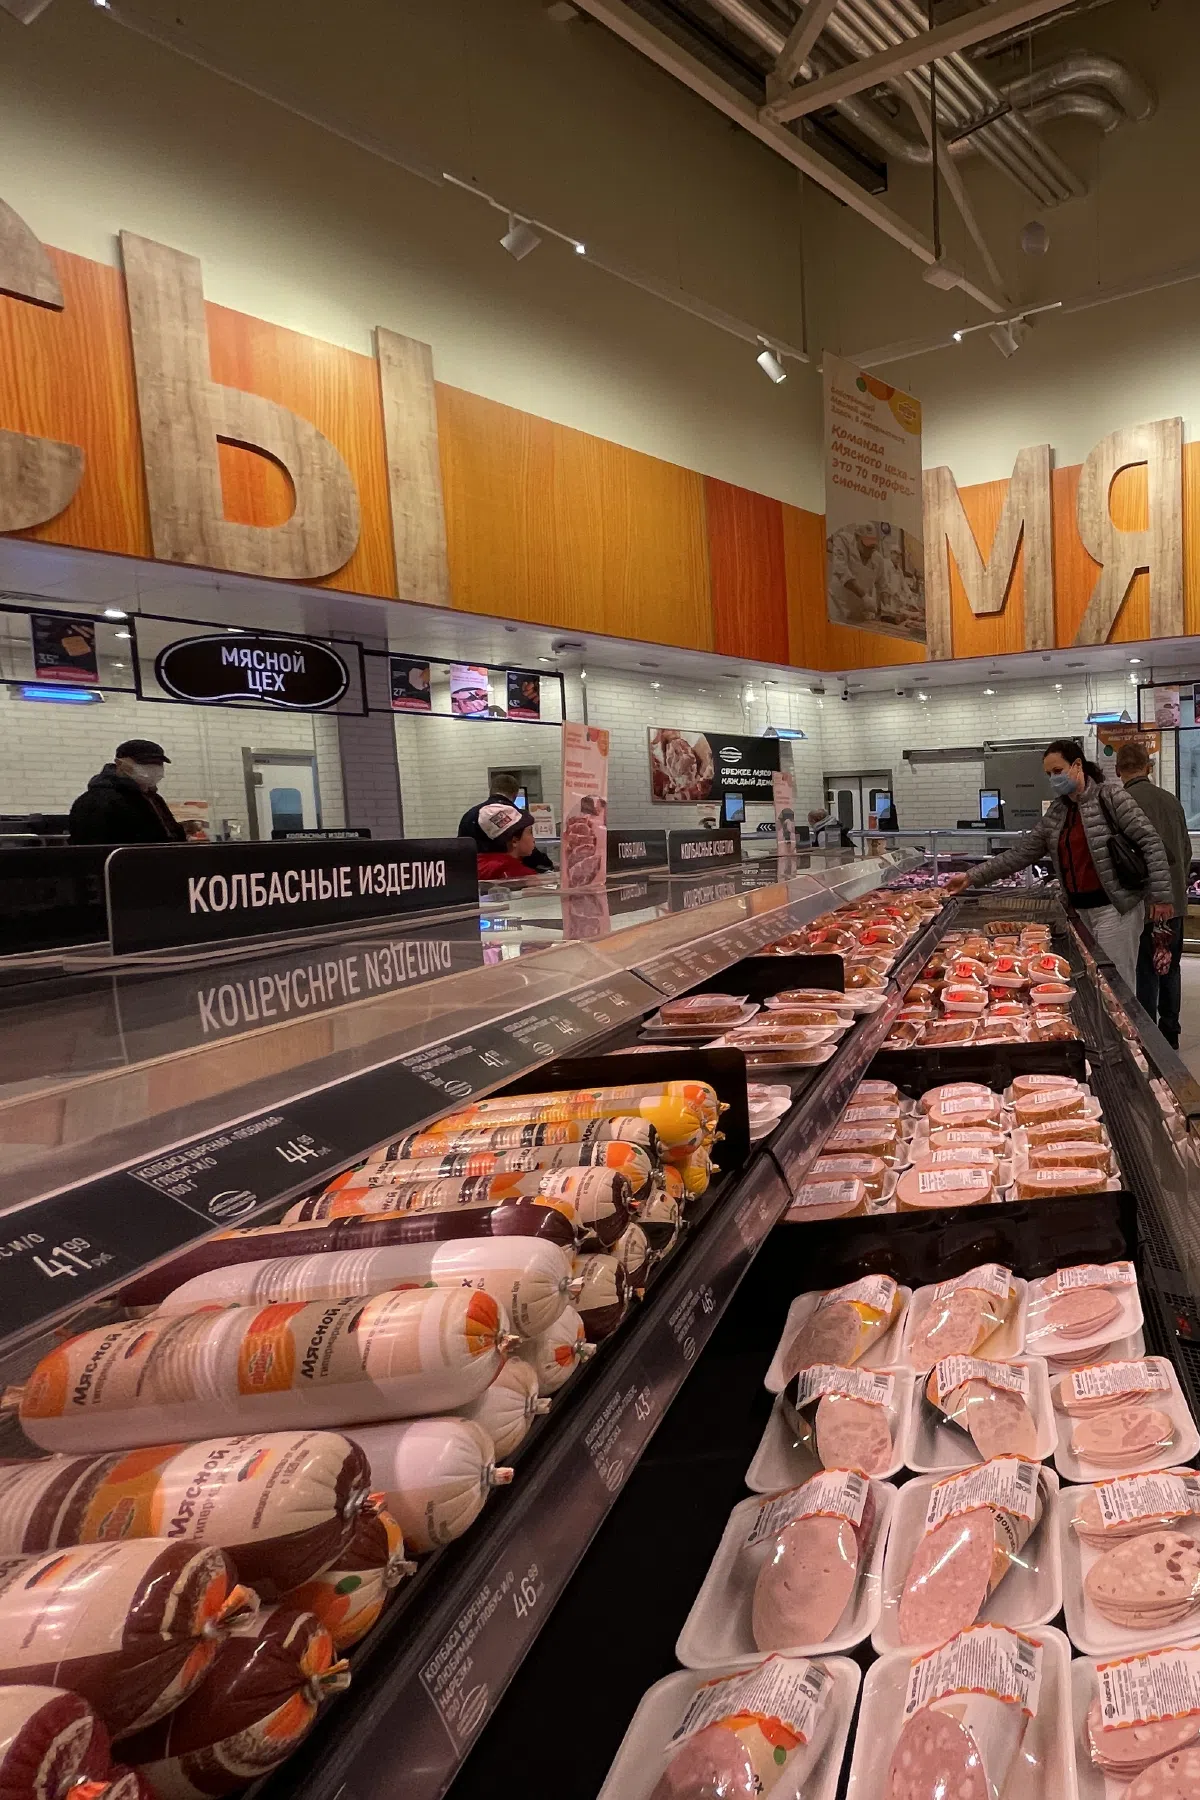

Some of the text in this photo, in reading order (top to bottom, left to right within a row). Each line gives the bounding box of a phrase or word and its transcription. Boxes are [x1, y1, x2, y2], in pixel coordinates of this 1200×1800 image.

[856, 464, 868, 480] 70
[832, 474, 888, 501] сионалов
[221, 646, 306, 674] МЯСНОЙ
[247, 670, 286, 692] ЦЕХ
[720, 767, 752, 776] СВЕЖЕЕ
[721, 777, 756, 786] КАЖДЫЙ
[680, 841, 713, 860] КОЛБАСНЫЕ
[188, 860, 447, 914] КОЛБАСНЫЕ ИЗДЕЛИЯ
[275, 1140, 318, 1165] 44
[137, 1154, 188, 1180] КОЛБАСА
[167, 1180, 192, 1198] 100
[32, 1237, 92, 1278] 41 99
[301, 1307, 341, 1378] Мясной
[72, 1333, 122, 1405] Мясной
[168, 1449, 230, 1538] Мясной
[512, 1577, 538, 1619] 46
[424, 1584, 492, 1684] КОЛБАСА ВАРЕНАЯ
[438, 1655, 474, 1710] НАРЕЗКА
